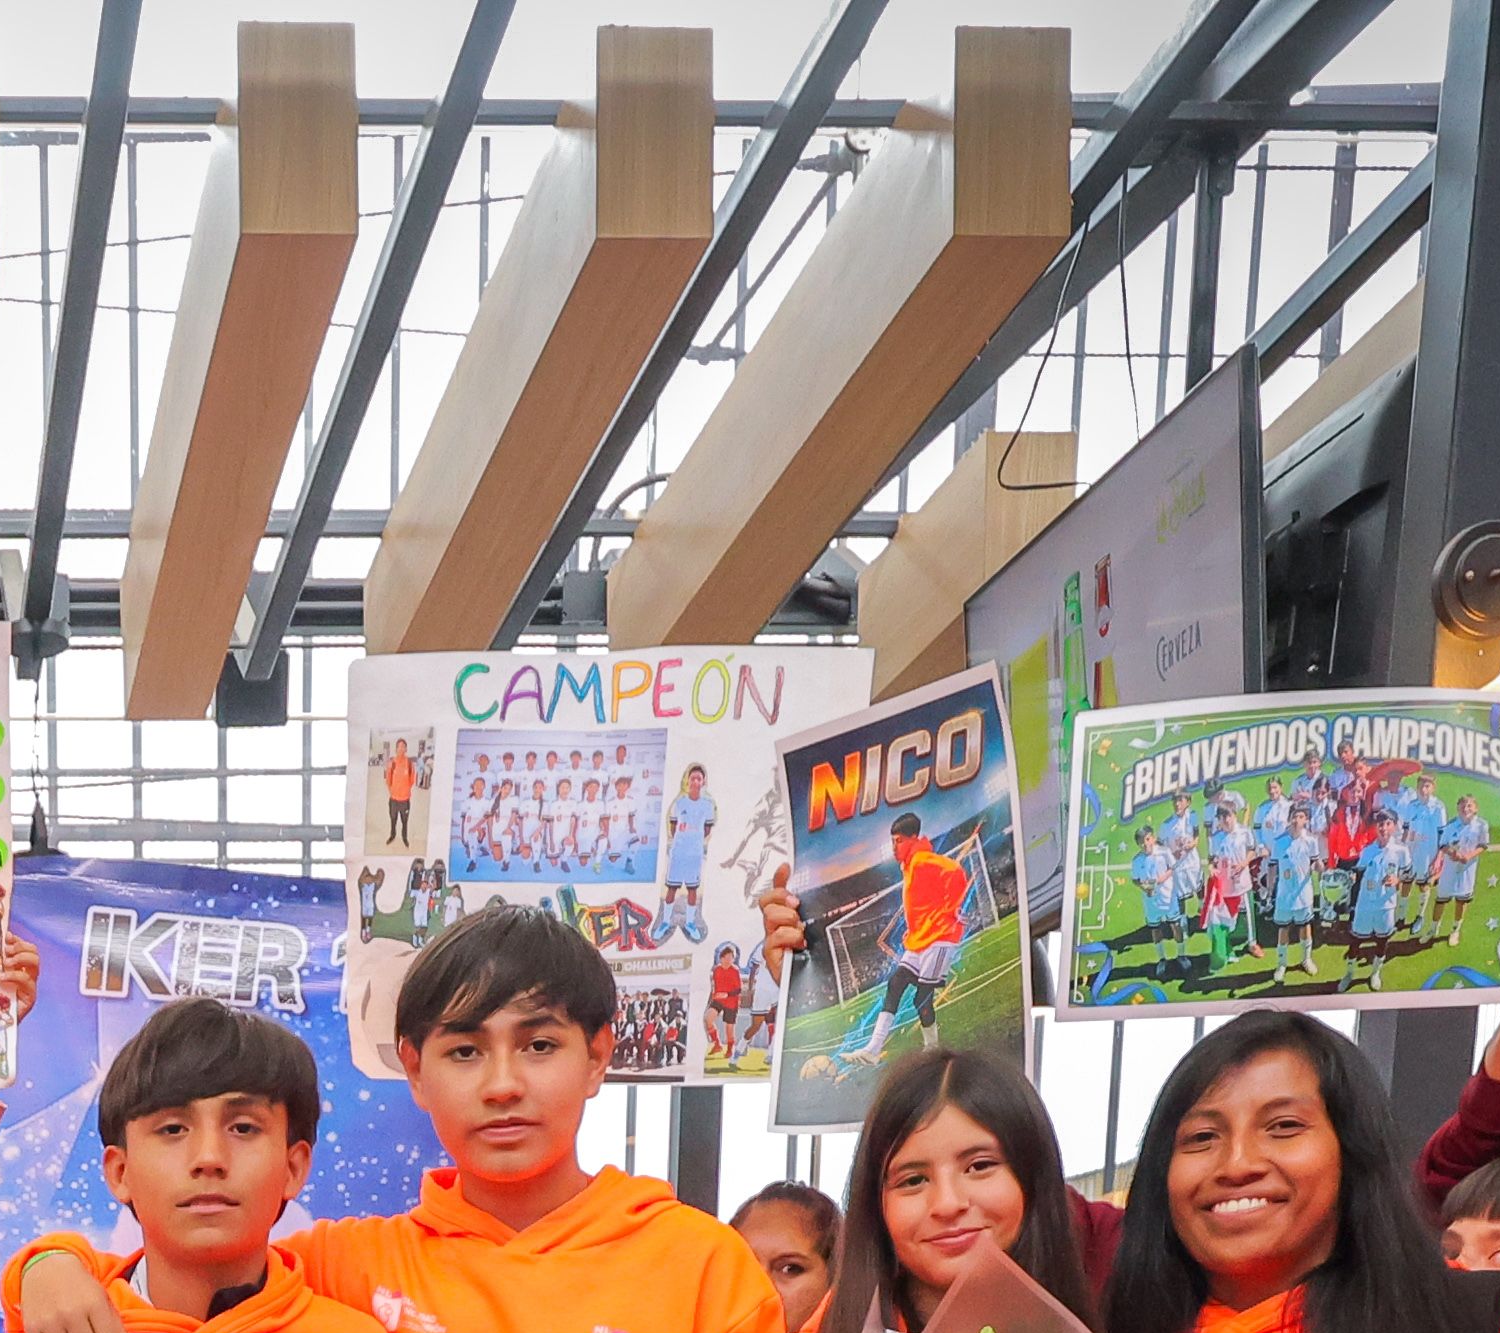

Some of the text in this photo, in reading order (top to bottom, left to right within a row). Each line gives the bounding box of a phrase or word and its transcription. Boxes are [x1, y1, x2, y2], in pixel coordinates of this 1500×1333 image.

[452, 651, 786, 726] CAMPEÓN
[1156, 620, 1203, 683] CERVEZA
[808, 707, 984, 831] NICO
[541, 884, 658, 952] KER
[80, 904, 308, 1014] IKER
